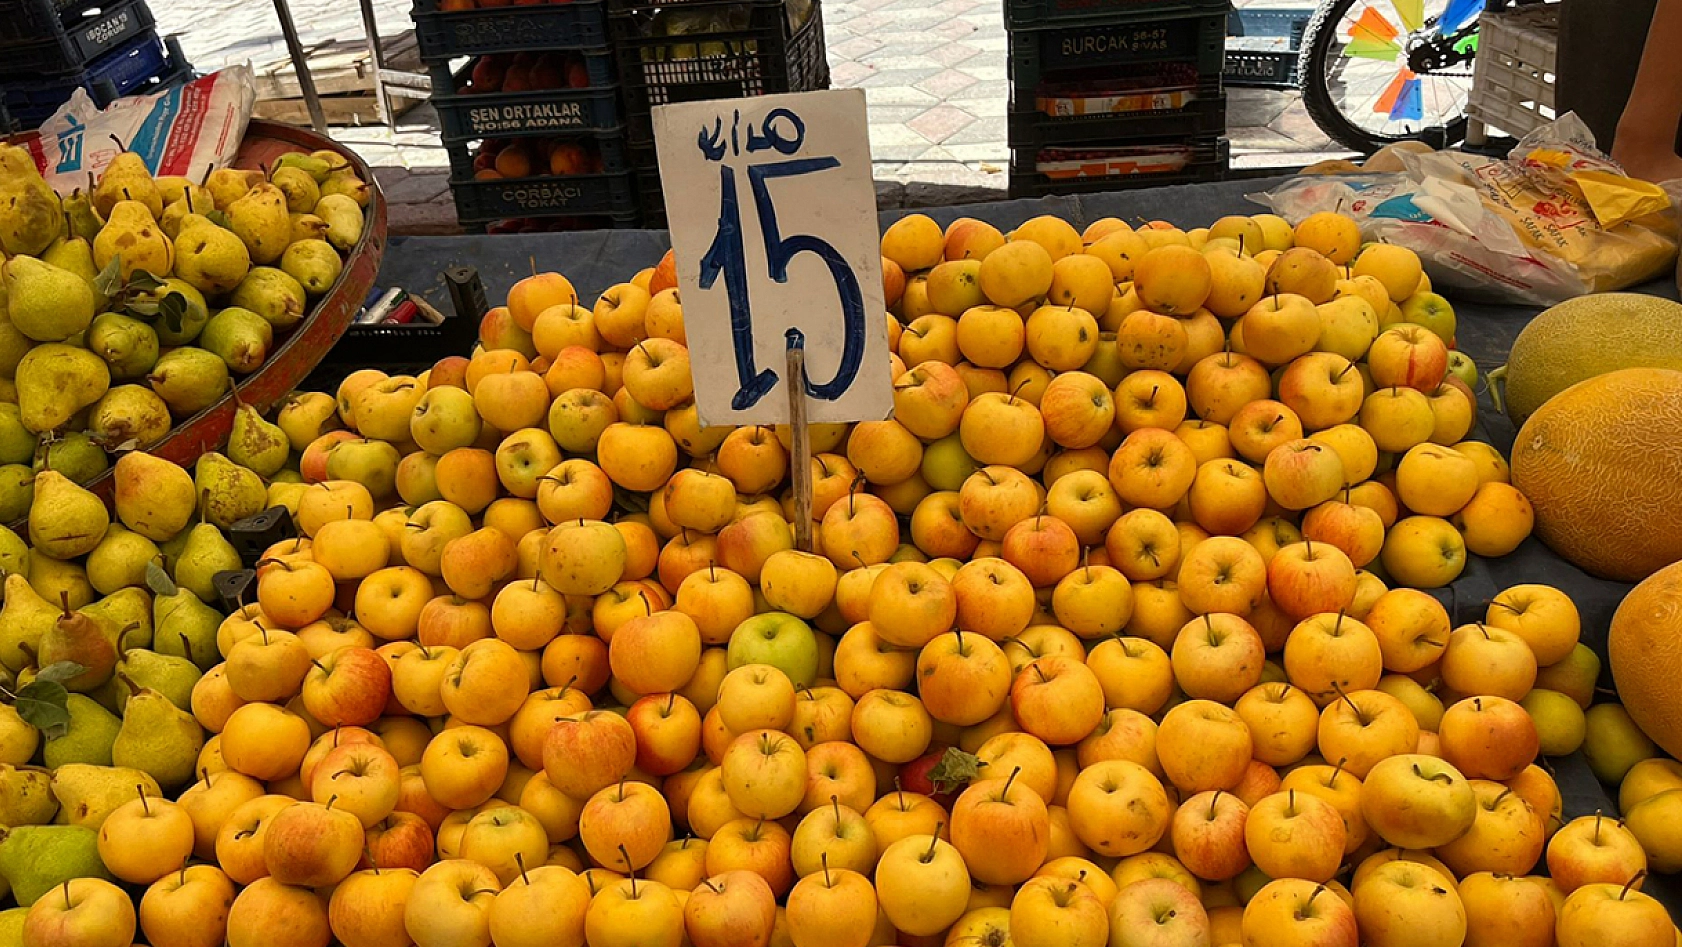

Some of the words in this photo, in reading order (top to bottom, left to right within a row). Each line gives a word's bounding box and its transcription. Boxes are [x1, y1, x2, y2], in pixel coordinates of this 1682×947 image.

[503, 102, 582, 120] ORTAKLAR
[524, 117, 584, 129] ADANA
[517, 198, 569, 208] TOKAT
[699, 156, 866, 410] 15
